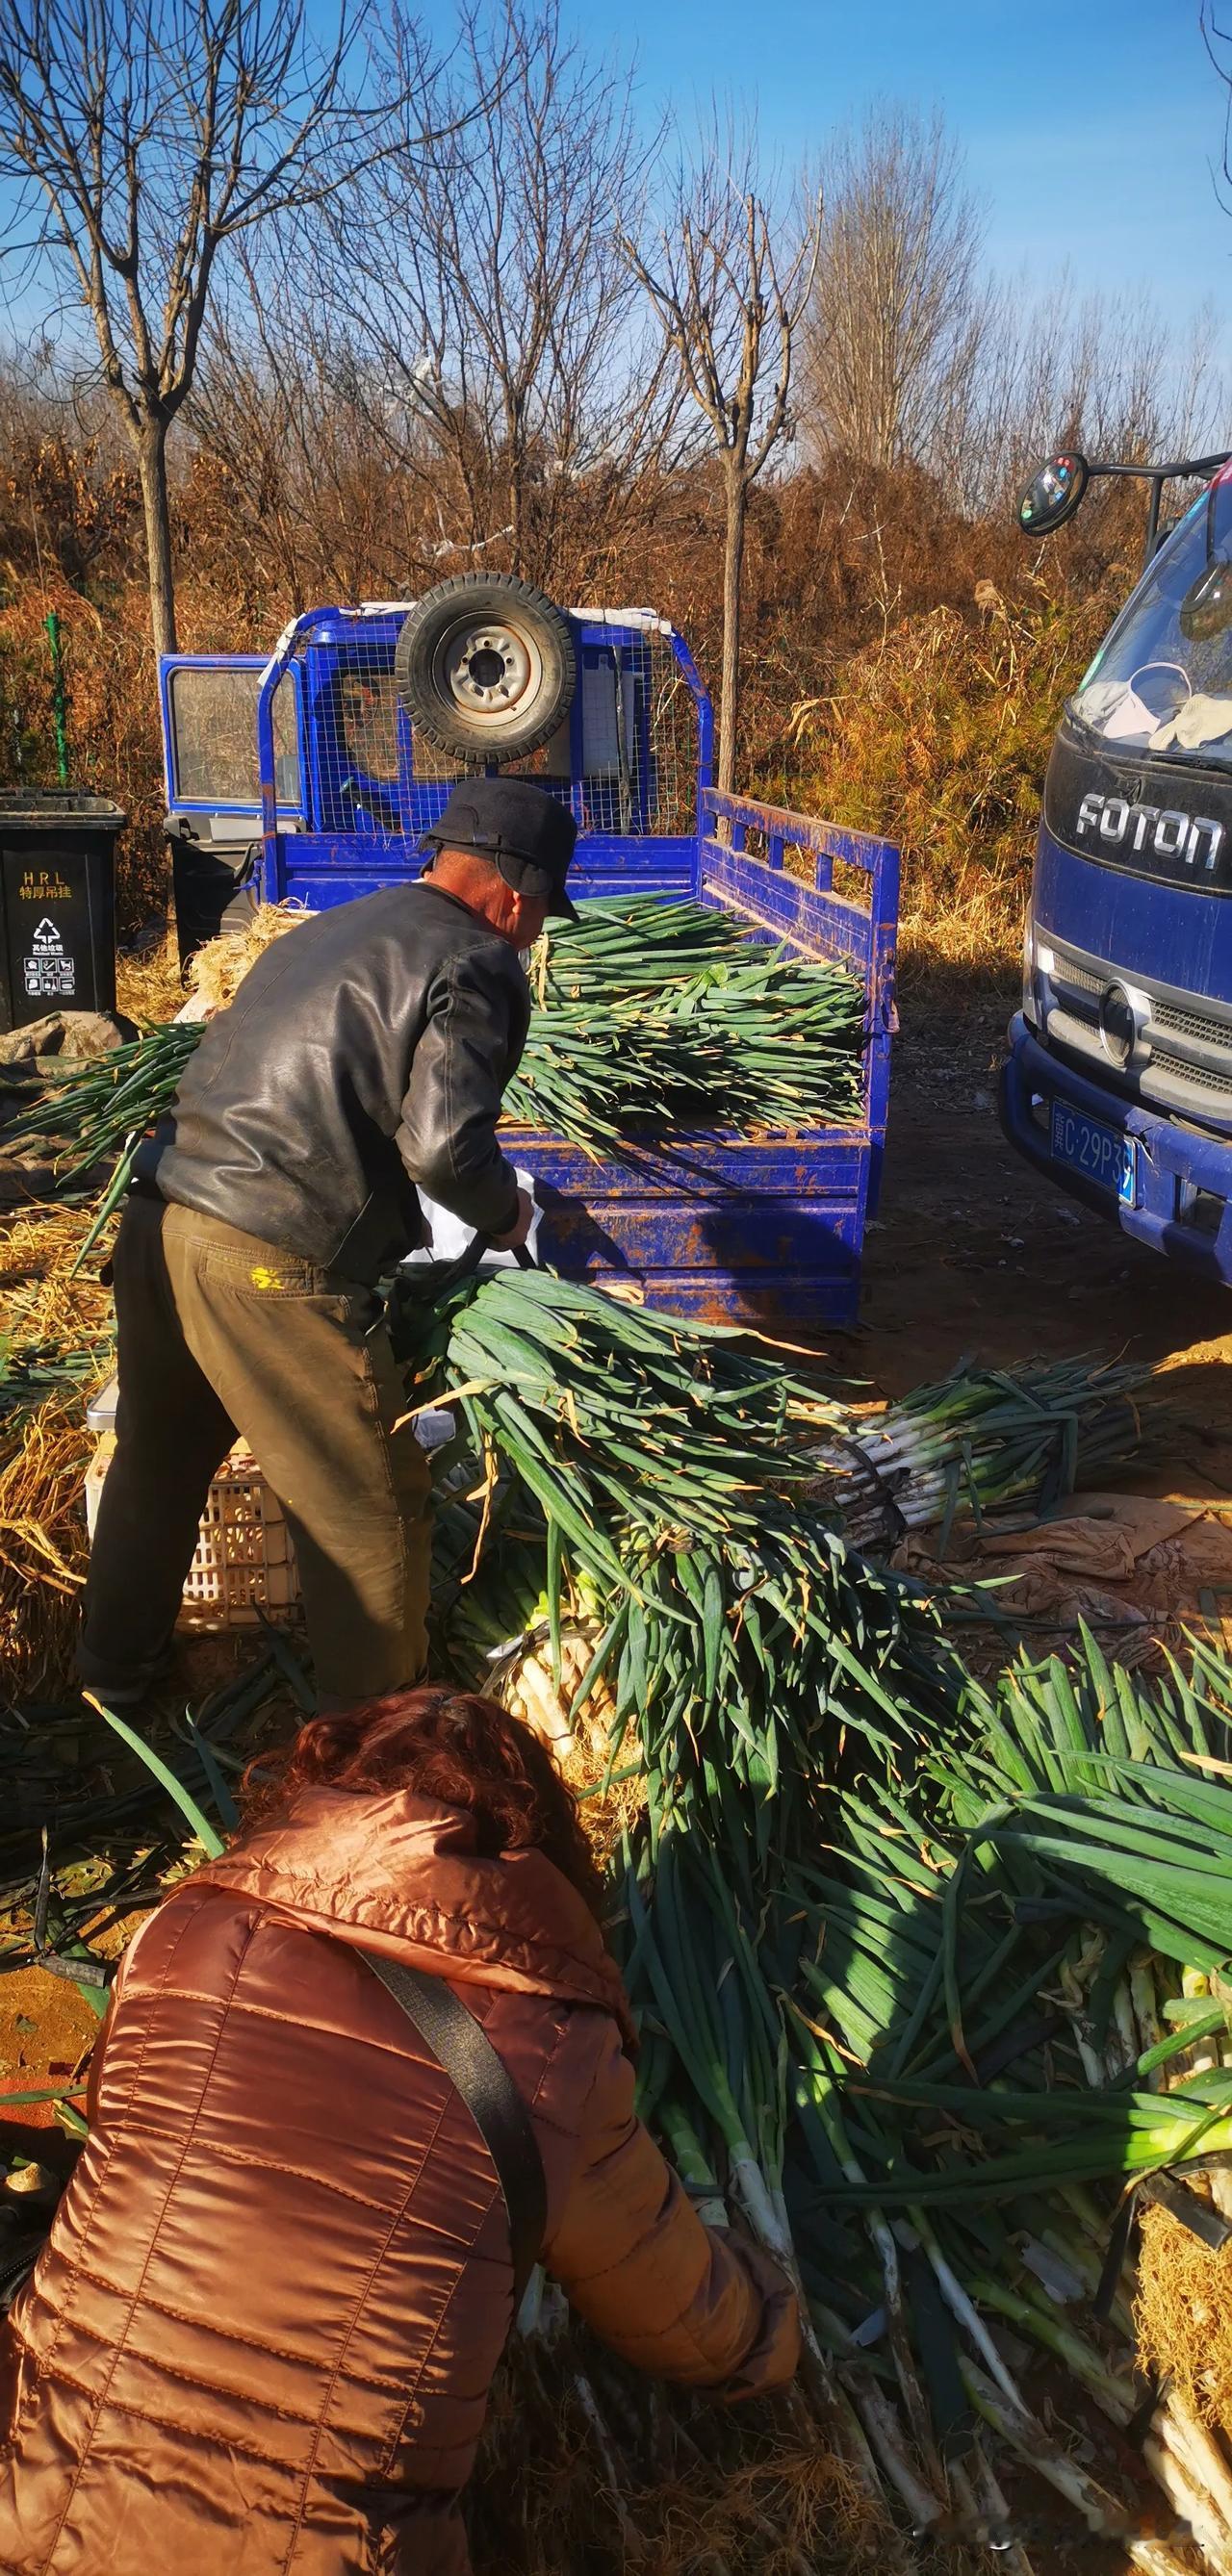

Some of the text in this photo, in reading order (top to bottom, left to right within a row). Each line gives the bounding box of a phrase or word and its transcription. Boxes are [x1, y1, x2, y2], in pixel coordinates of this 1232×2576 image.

[1076, 793, 1223, 870] FOTON
[19, 885, 72, 900] 特厚吊挂
